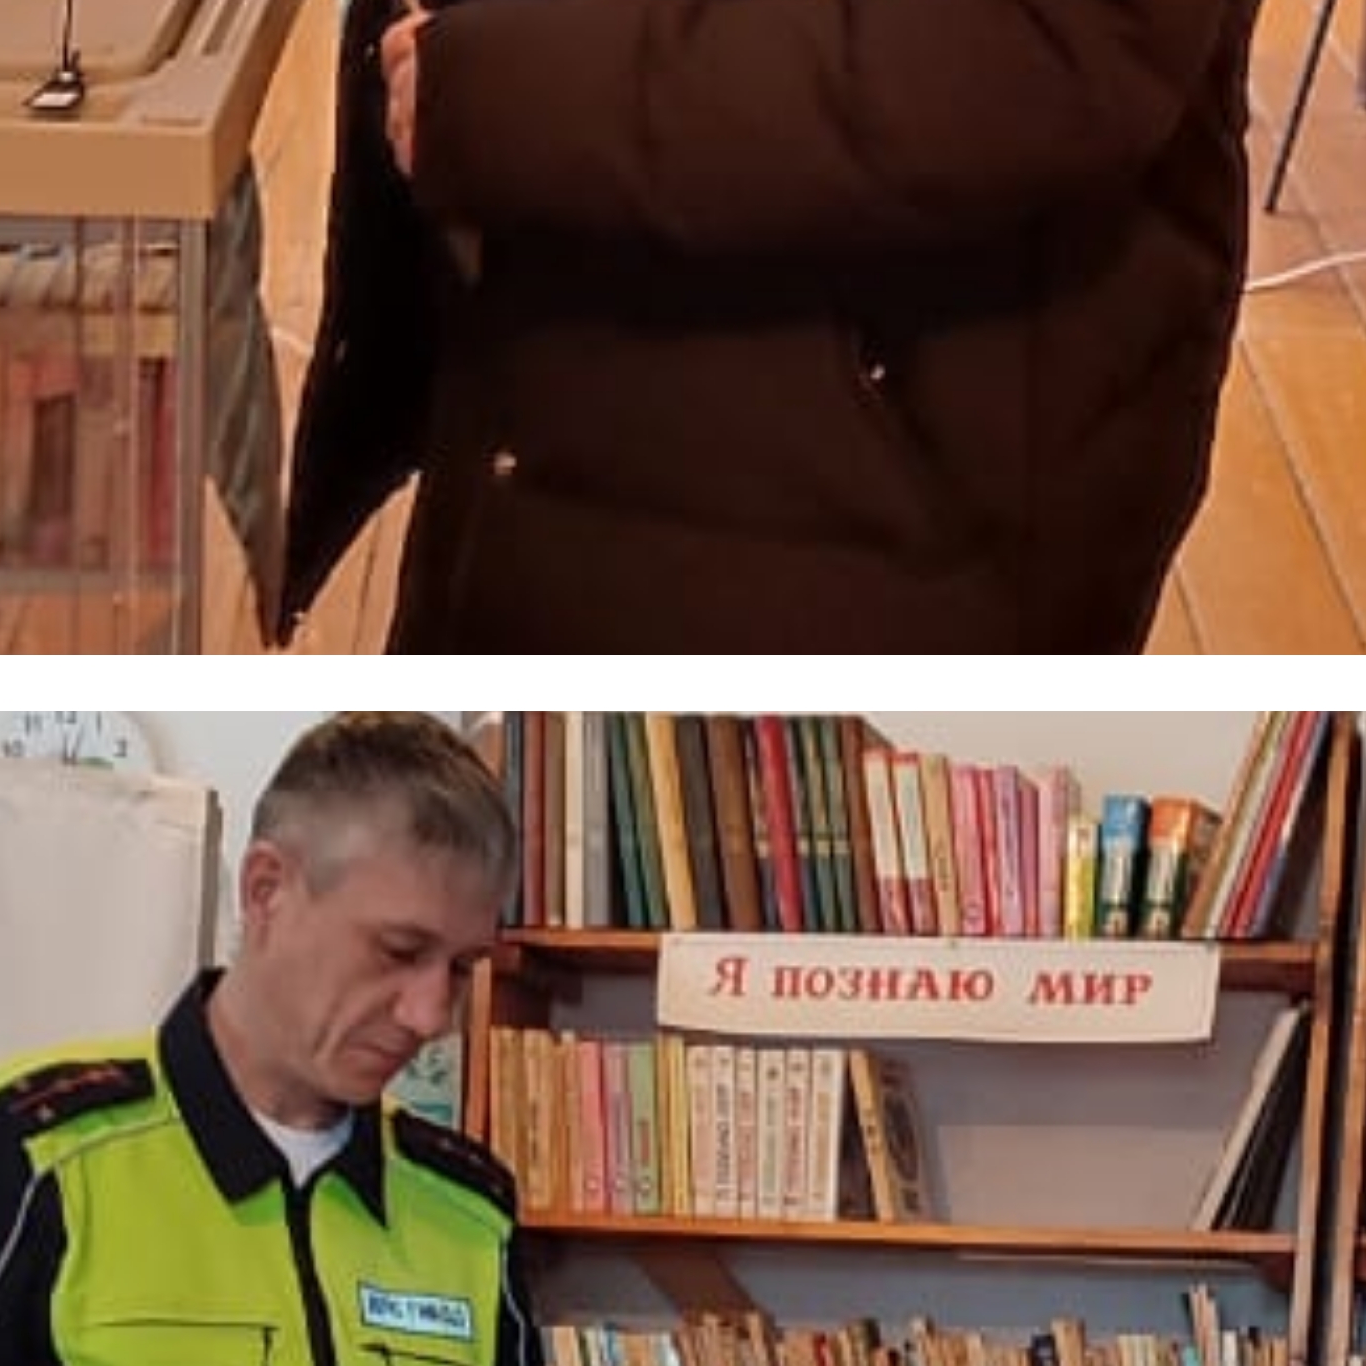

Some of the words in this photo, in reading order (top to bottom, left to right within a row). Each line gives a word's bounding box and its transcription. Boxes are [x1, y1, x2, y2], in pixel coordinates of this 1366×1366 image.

[709, 956, 749, 998] Я
[771, 964, 995, 1003] ПОЗНАЮ
[1028, 968, 1153, 1006] МИР
